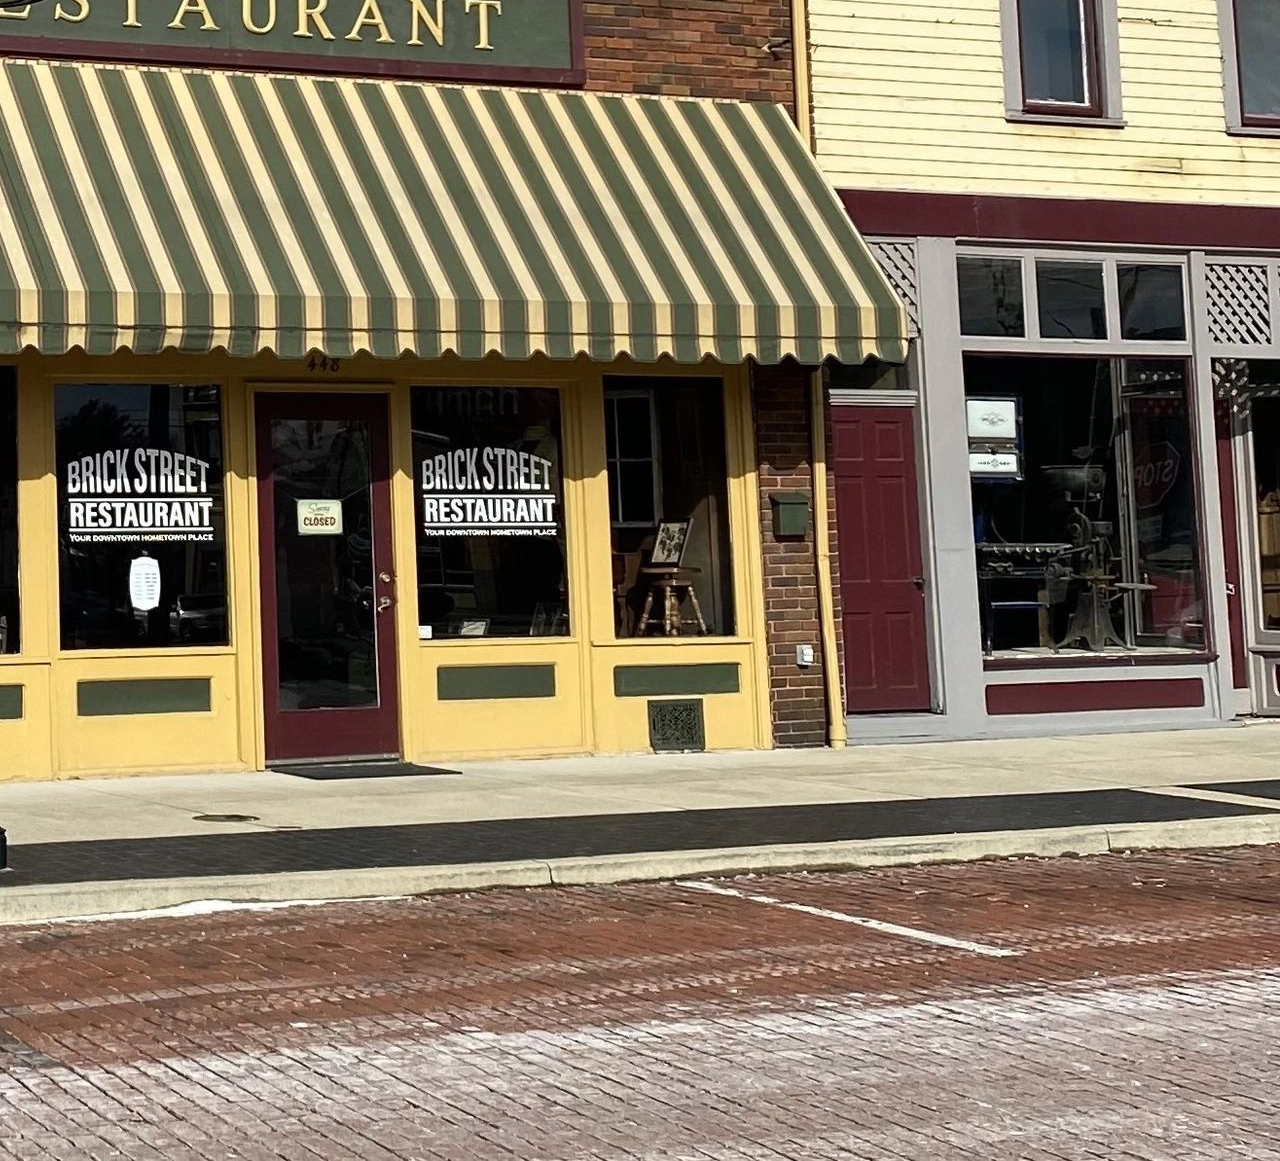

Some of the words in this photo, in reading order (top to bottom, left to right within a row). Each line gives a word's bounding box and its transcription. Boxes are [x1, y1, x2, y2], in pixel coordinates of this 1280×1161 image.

[307, 355, 340, 372] 448
[67, 448, 132, 494] BRICK
[133, 447, 210, 494] STREET
[422, 447, 481, 490] BRICK
[482, 446, 552, 490] STREET
[70, 501, 214, 527] RESTAURANT
[303, 516, 337, 526] CLOSED
[425, 498, 556, 523] RESTAURANT
[92, 533, 141, 542] DOWNTOWN
[141, 533, 187, 541] HOMETOWN
[188, 533, 214, 541] PLACE
[446, 528, 490, 536] DOWNTOWN
[490, 528, 533, 536] HOMETOWN
[533, 528, 557, 536] PLACE
